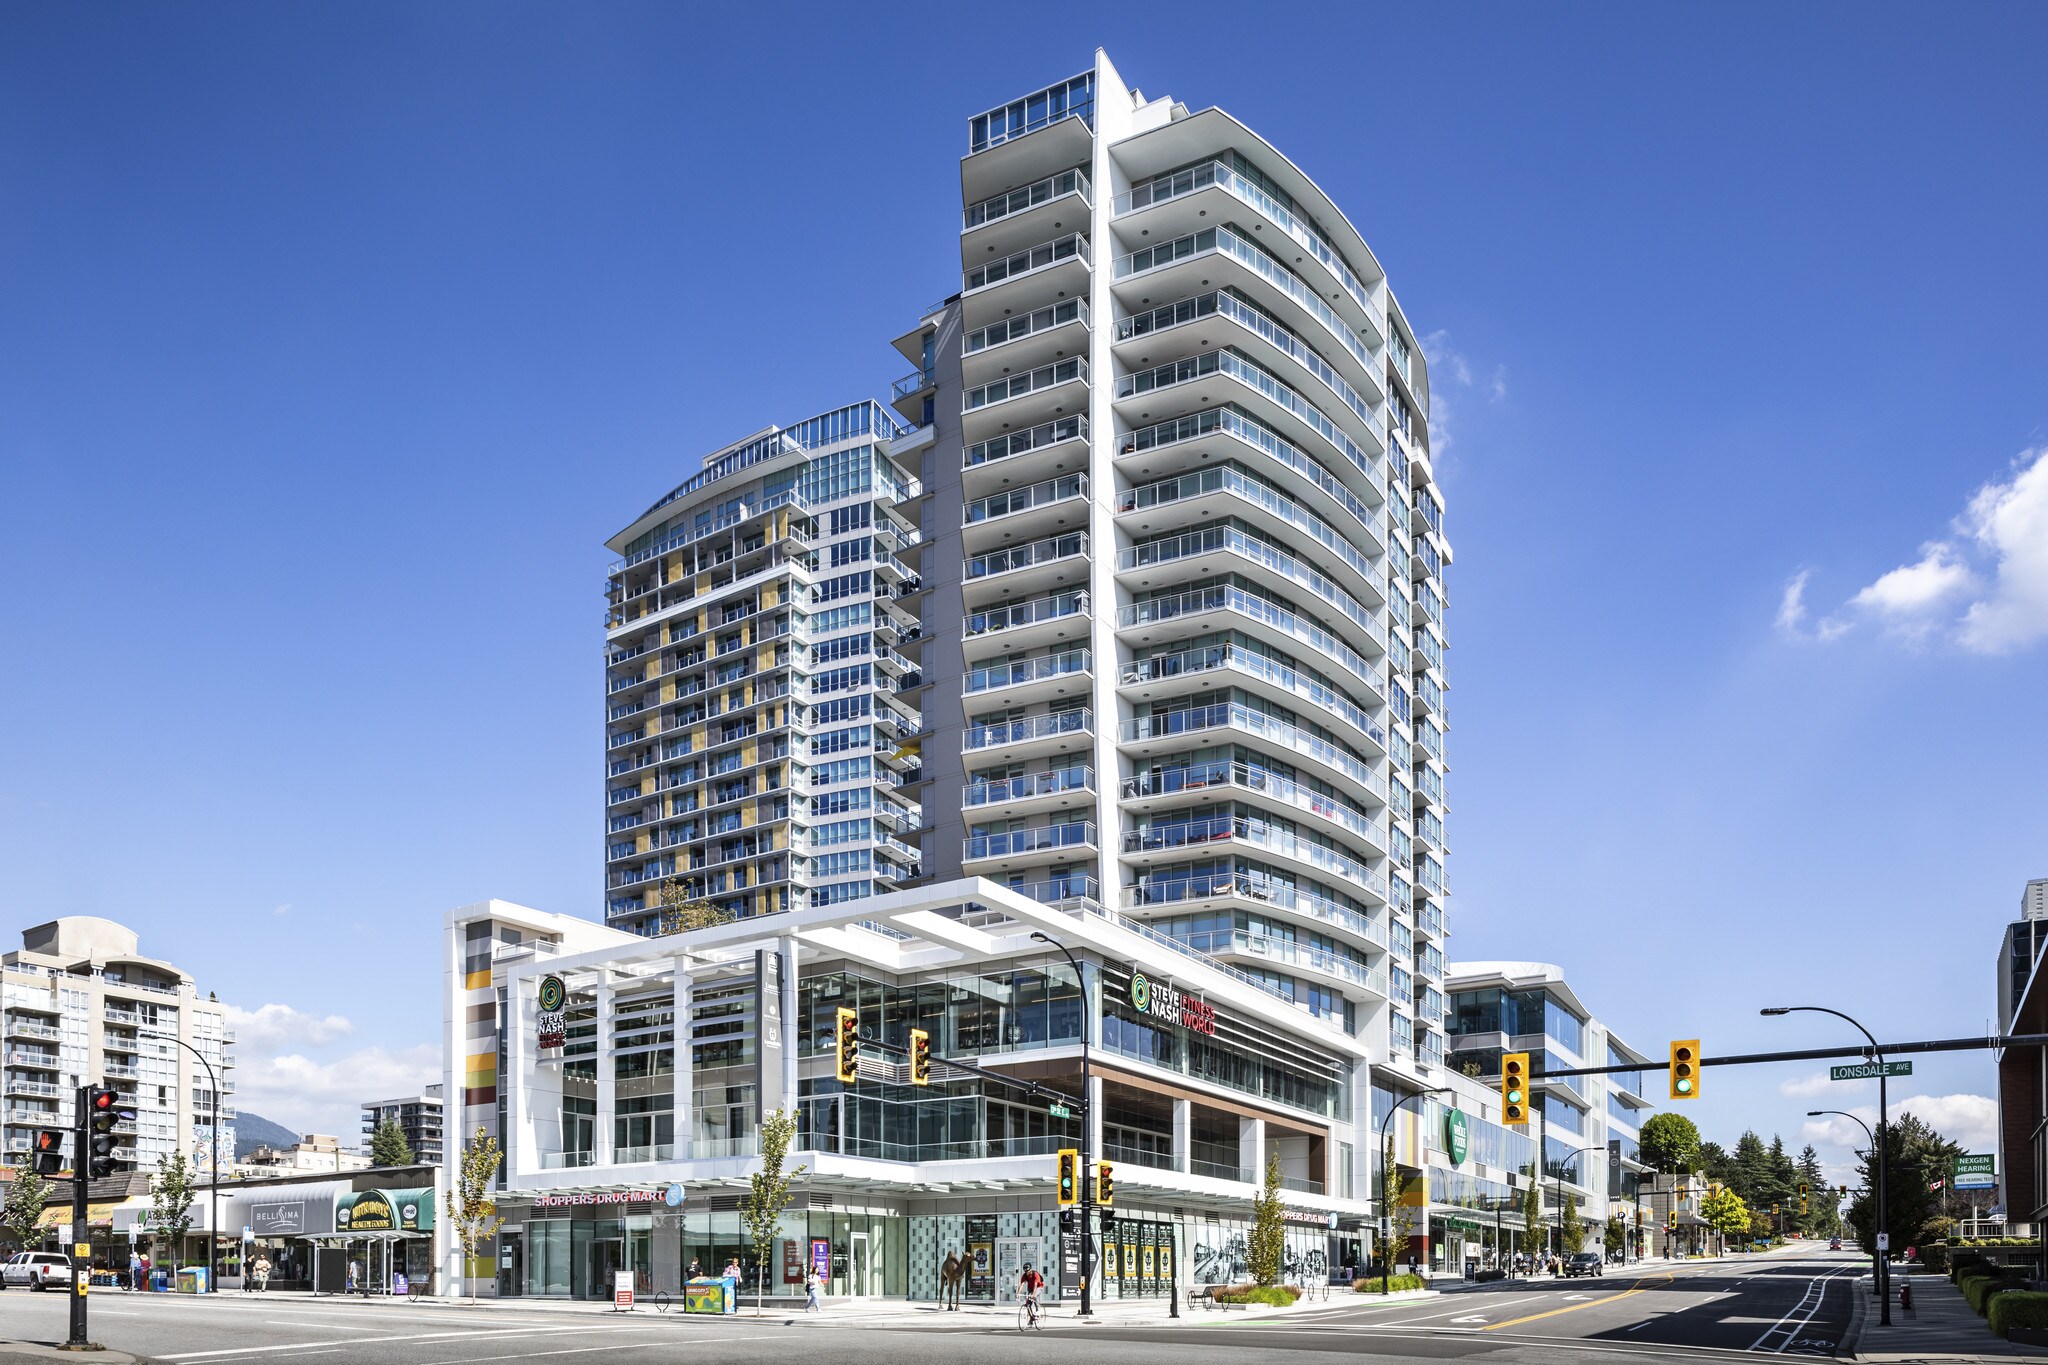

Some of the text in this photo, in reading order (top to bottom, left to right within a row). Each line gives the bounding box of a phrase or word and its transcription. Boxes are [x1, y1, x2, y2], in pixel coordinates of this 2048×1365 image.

[1152, 983, 1179, 1007] STEVE
[1152, 999, 1179, 1024] NASH
[1182, 995, 1215, 1020] FITNESS
[539, 1013, 564, 1024] STEVE
[1182, 1011, 1215, 1035] WORLD
[539, 1022, 564, 1033] NASH
[1833, 1063, 1909, 1079] LONSDALE AVE
[1453, 1123, 1467, 1138] WHOLE
[1454, 1135, 1467, 1149] FOODS
[535, 1190, 666, 1207] SHOPPERS DRUG MART
[351, 1220, 371, 1228] HEALTH
[371, 1219, 390, 1228] FOODS
